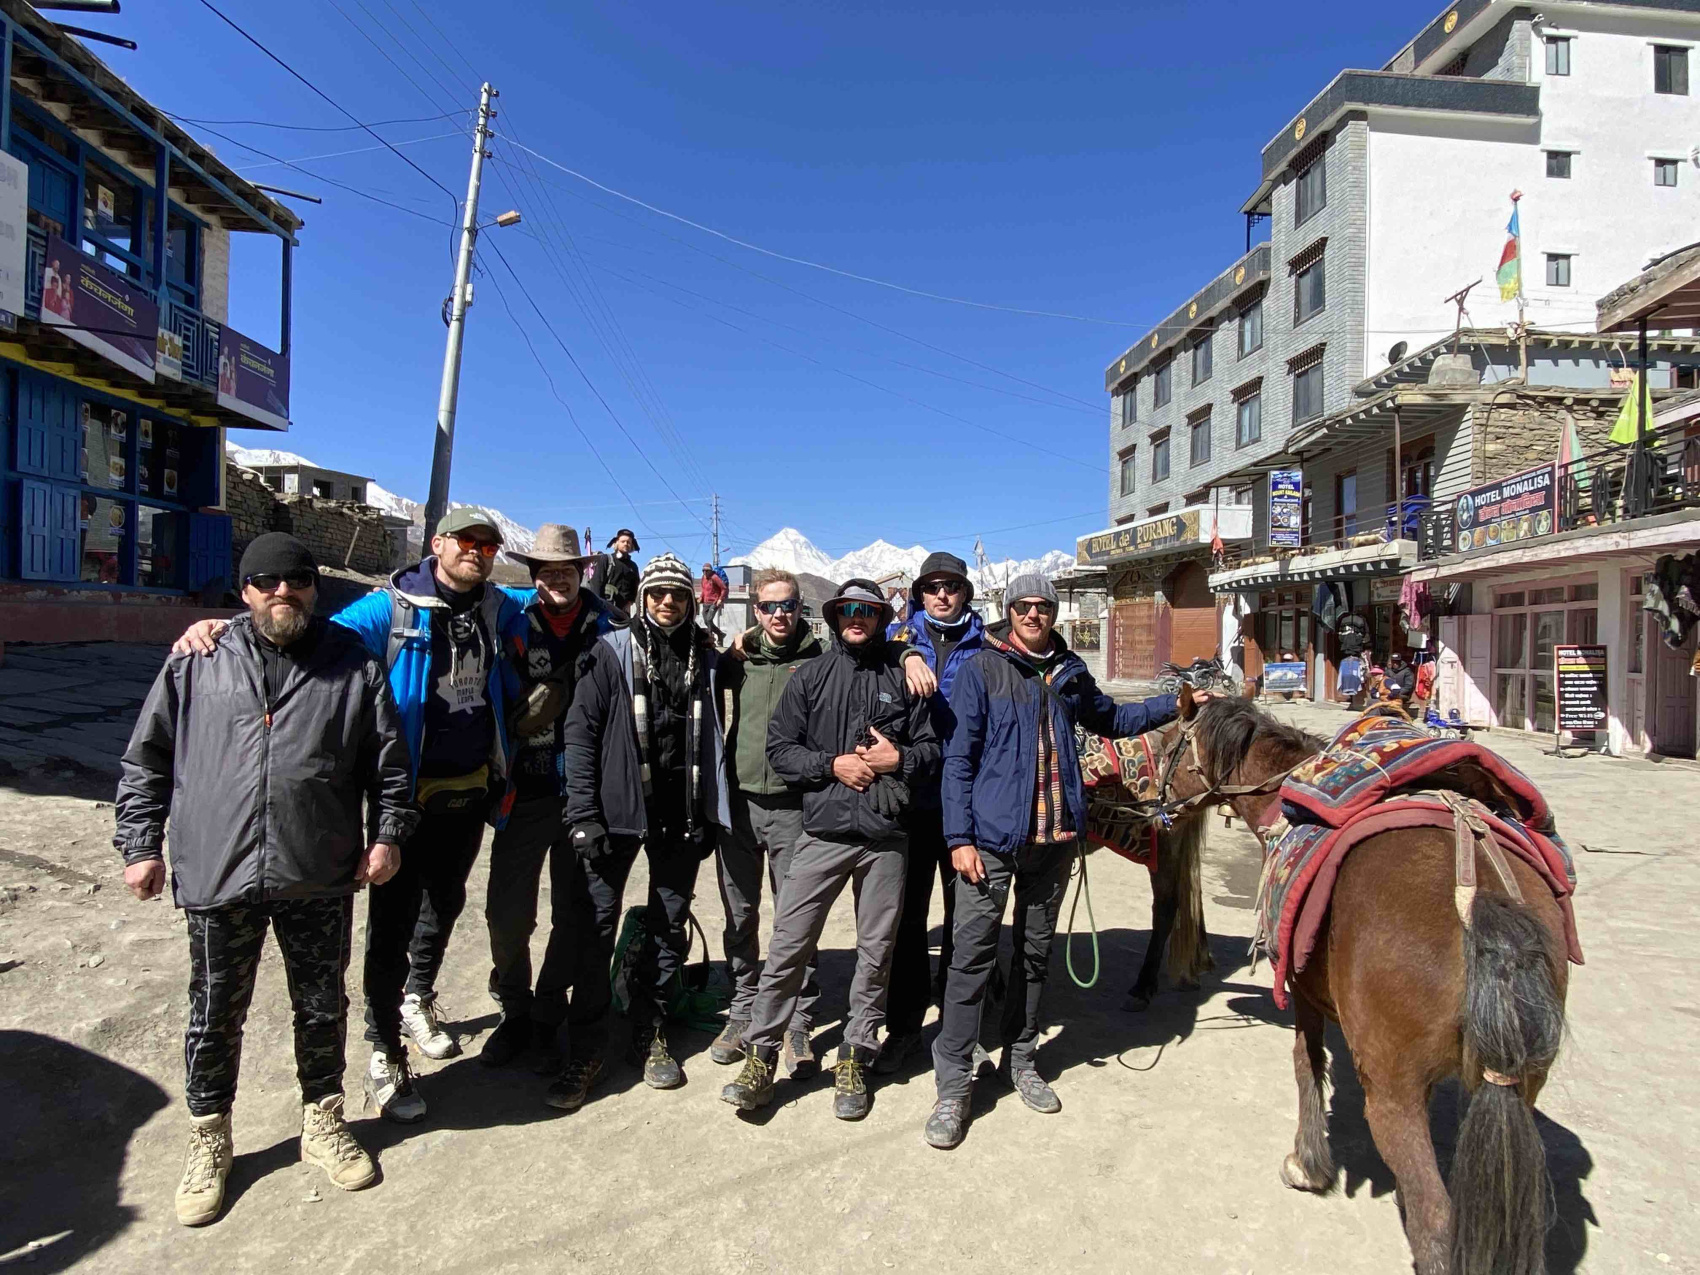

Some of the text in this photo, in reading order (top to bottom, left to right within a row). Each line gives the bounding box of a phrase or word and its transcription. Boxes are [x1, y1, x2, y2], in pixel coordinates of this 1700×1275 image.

[1475, 490, 1501, 507] HOTEL
[1503, 473, 1550, 499] MONALISA
[1091, 534, 1117, 553] HOTEL
[1137, 517, 1177, 543] PURANG
[457, 687, 474, 697] MAPLE
[457, 695, 474, 705] LEAFS
[447, 798, 470, 808] CAT
